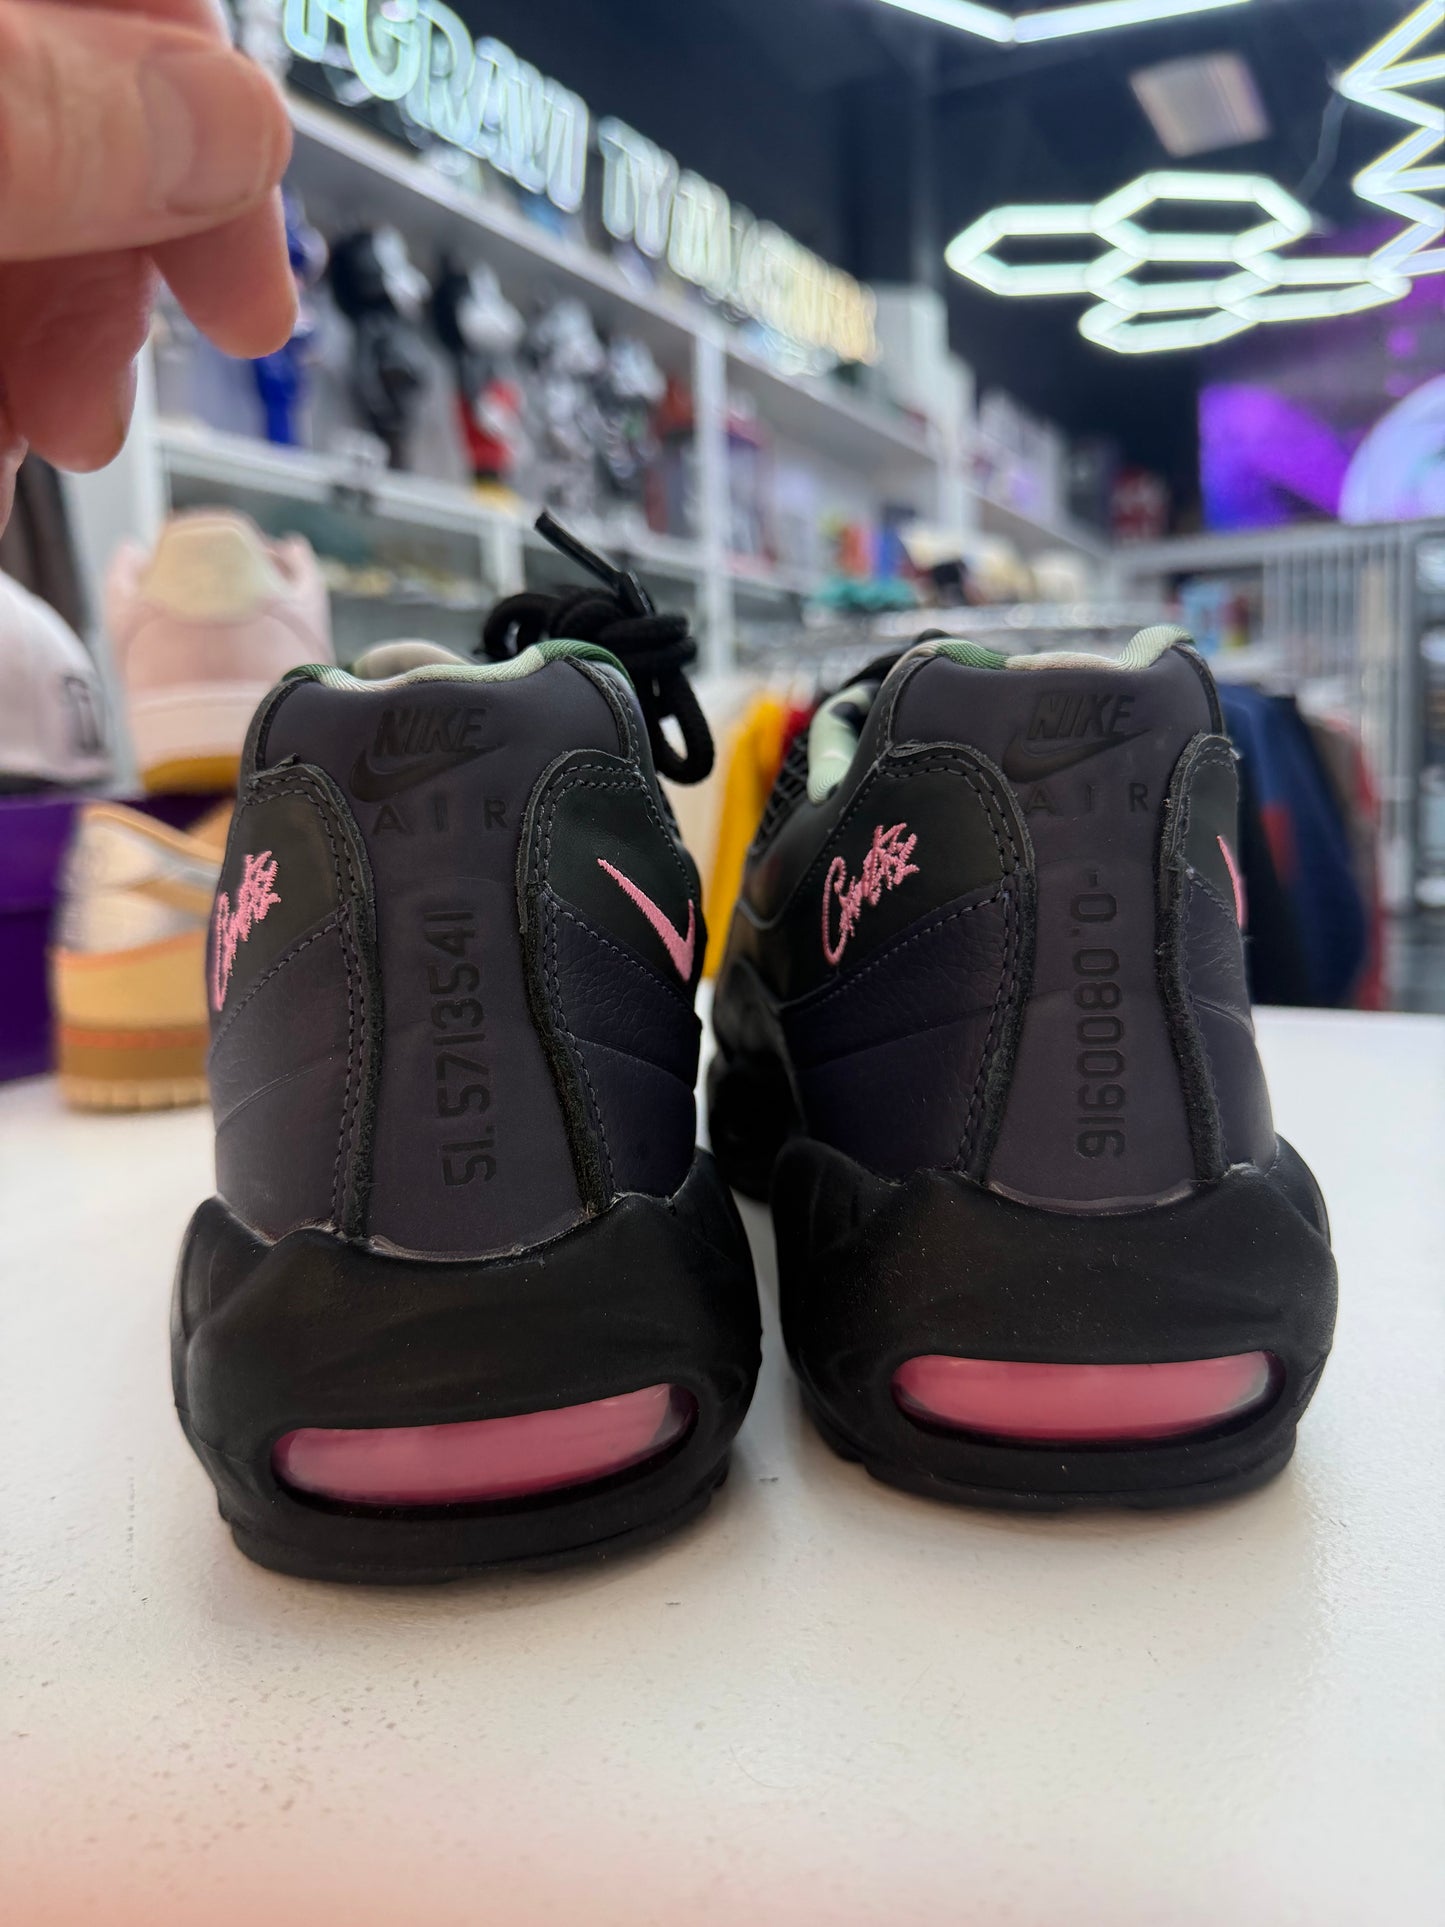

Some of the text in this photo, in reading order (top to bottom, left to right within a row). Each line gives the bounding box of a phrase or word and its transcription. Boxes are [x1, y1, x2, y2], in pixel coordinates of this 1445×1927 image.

[373, 708, 488, 757] NIKE
[1027, 692, 1137, 740] NIKE
[372, 797, 509, 836] AIR
[1025, 781, 1151, 816] AIR
[424, 910, 497, 1187] 51.5713541
